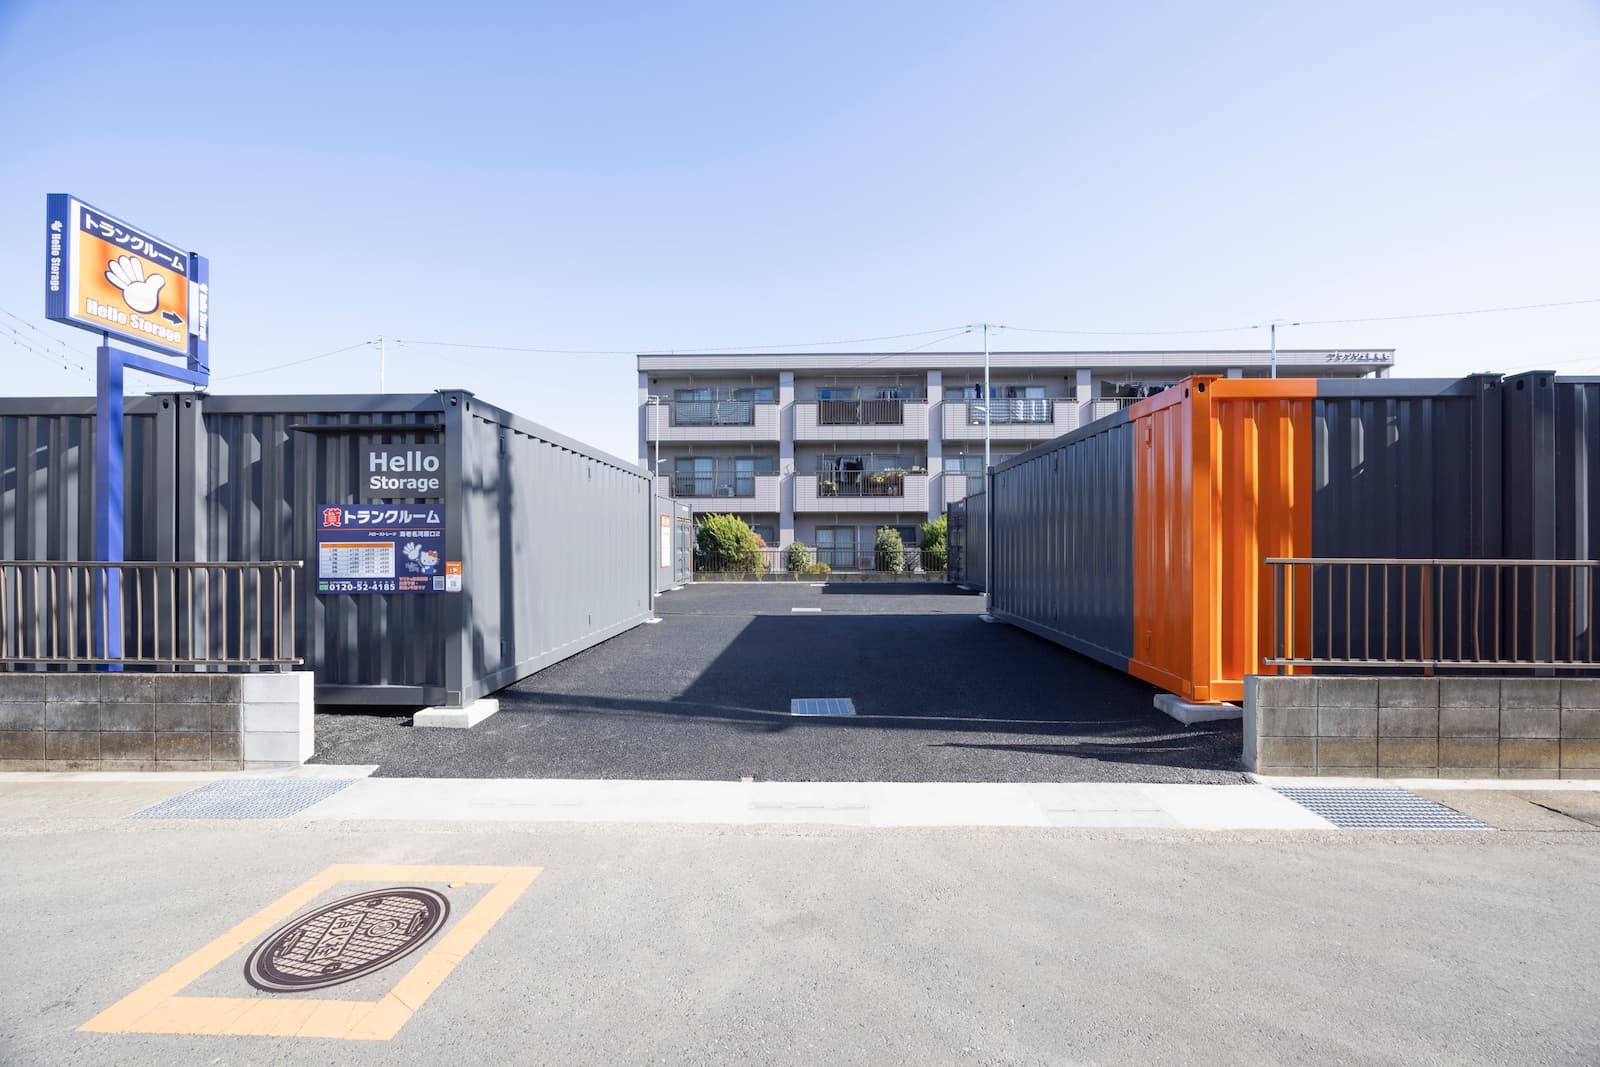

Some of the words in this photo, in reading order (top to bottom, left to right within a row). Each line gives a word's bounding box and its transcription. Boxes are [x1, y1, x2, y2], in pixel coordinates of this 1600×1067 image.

[51, 233, 62, 257] Hello
[85, 213, 185, 272] トランクルーム
[50, 257, 62, 292] Storage
[86, 297, 127, 325] Hello
[130, 313, 182, 343] Storage
[369, 451, 440, 472] Hello
[369, 475, 440, 493] Storage
[344, 510, 441, 524] トランクルーム
[329, 583, 396, 591] 0120-52-4185
